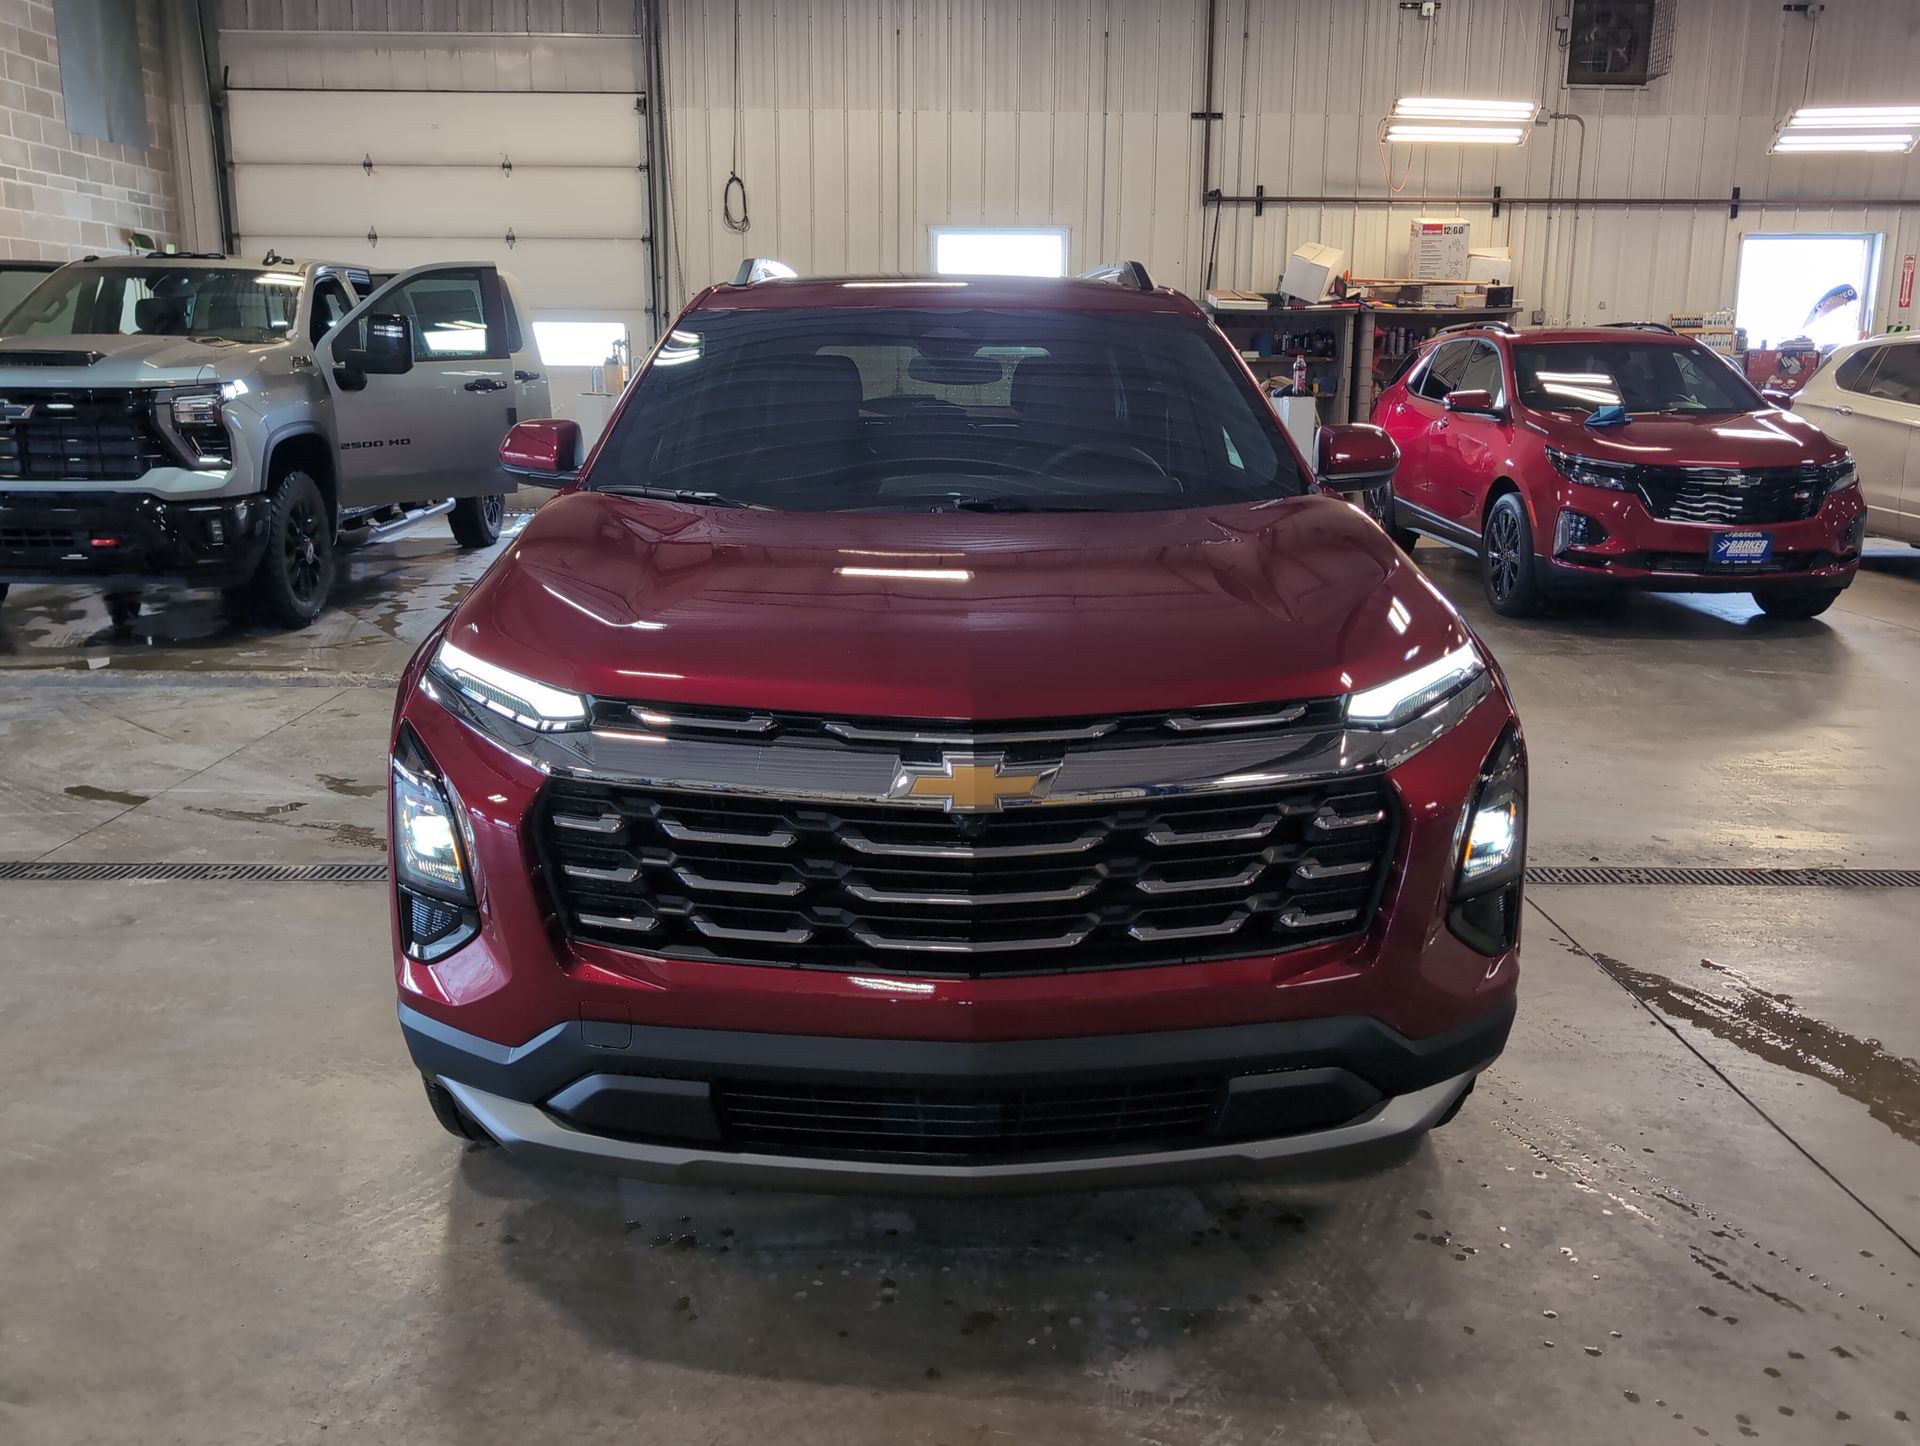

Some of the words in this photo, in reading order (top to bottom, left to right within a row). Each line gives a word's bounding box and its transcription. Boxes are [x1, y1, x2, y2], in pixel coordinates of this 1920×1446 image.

[340, 440, 383, 450] 2500
[389, 438, 411, 447] HD
[1728, 540, 1769, 552] BARKER
